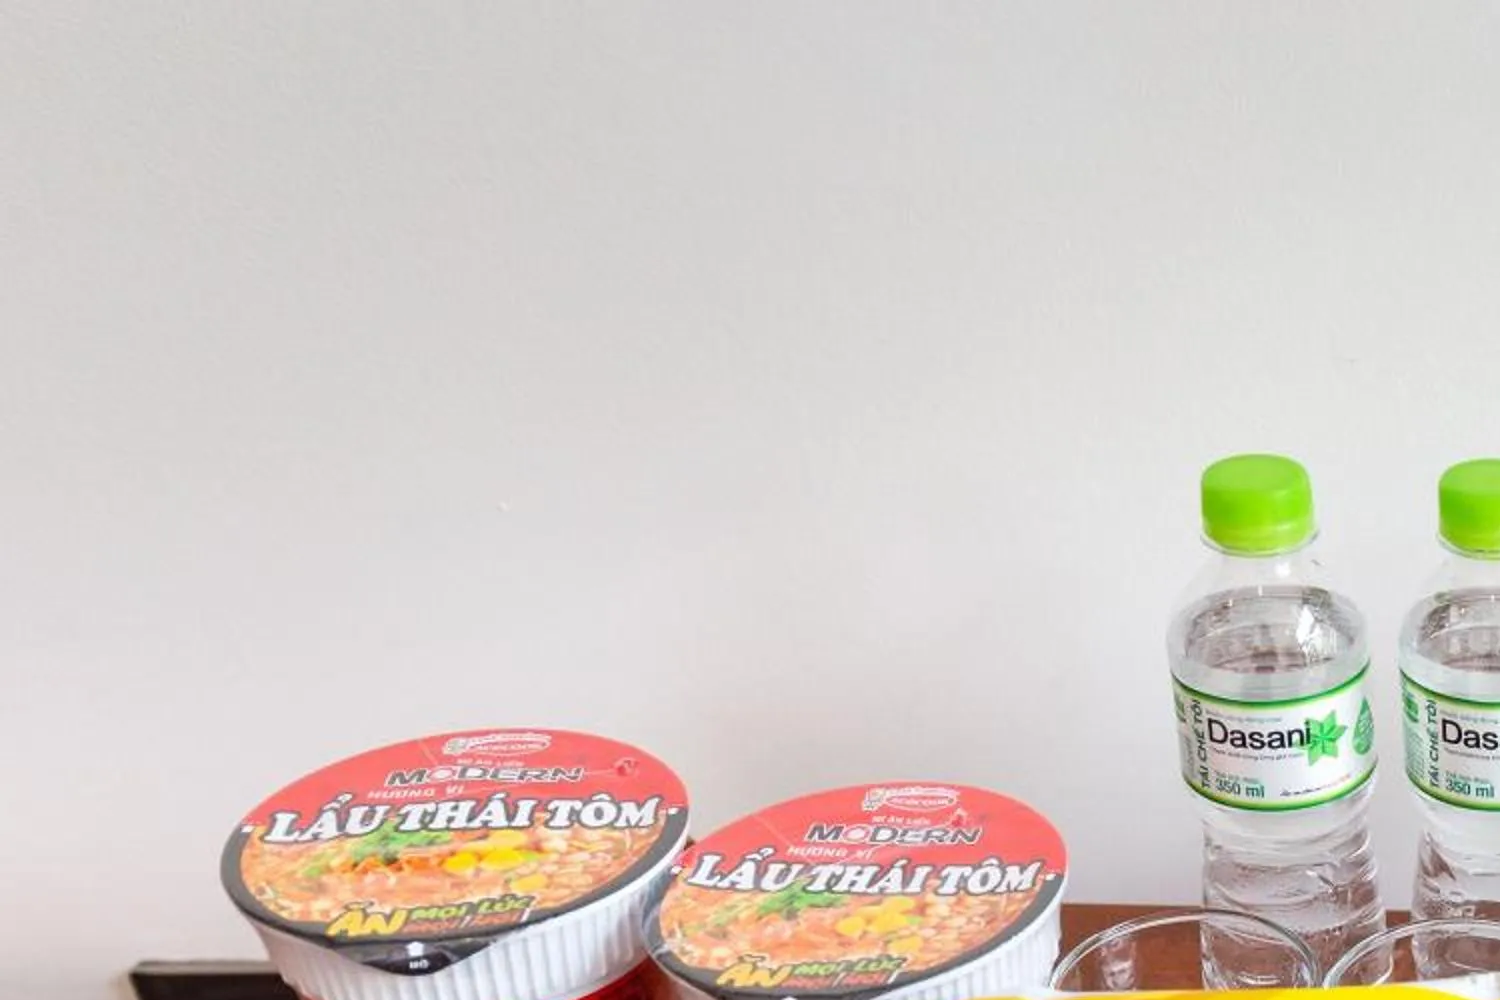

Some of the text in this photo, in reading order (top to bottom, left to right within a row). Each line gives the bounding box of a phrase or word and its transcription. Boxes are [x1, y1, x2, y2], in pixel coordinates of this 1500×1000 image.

[1207, 718, 1311, 750] Dasani
[384, 765, 586, 787] MODERN
[1215, 778, 1241, 795] 350
[1245, 784, 1265, 798] ml
[1445, 778, 1471, 796] 350
[1475, 785, 1495, 798] ml
[263, 791, 664, 844] LẨU THÁI TÔM
[803, 822, 983, 846] MODERN
[687, 846, 1042, 897] LẨU THÁI TÔM
[325, 902, 408, 937] ĂN
[716, 954, 793, 988] ĂN
